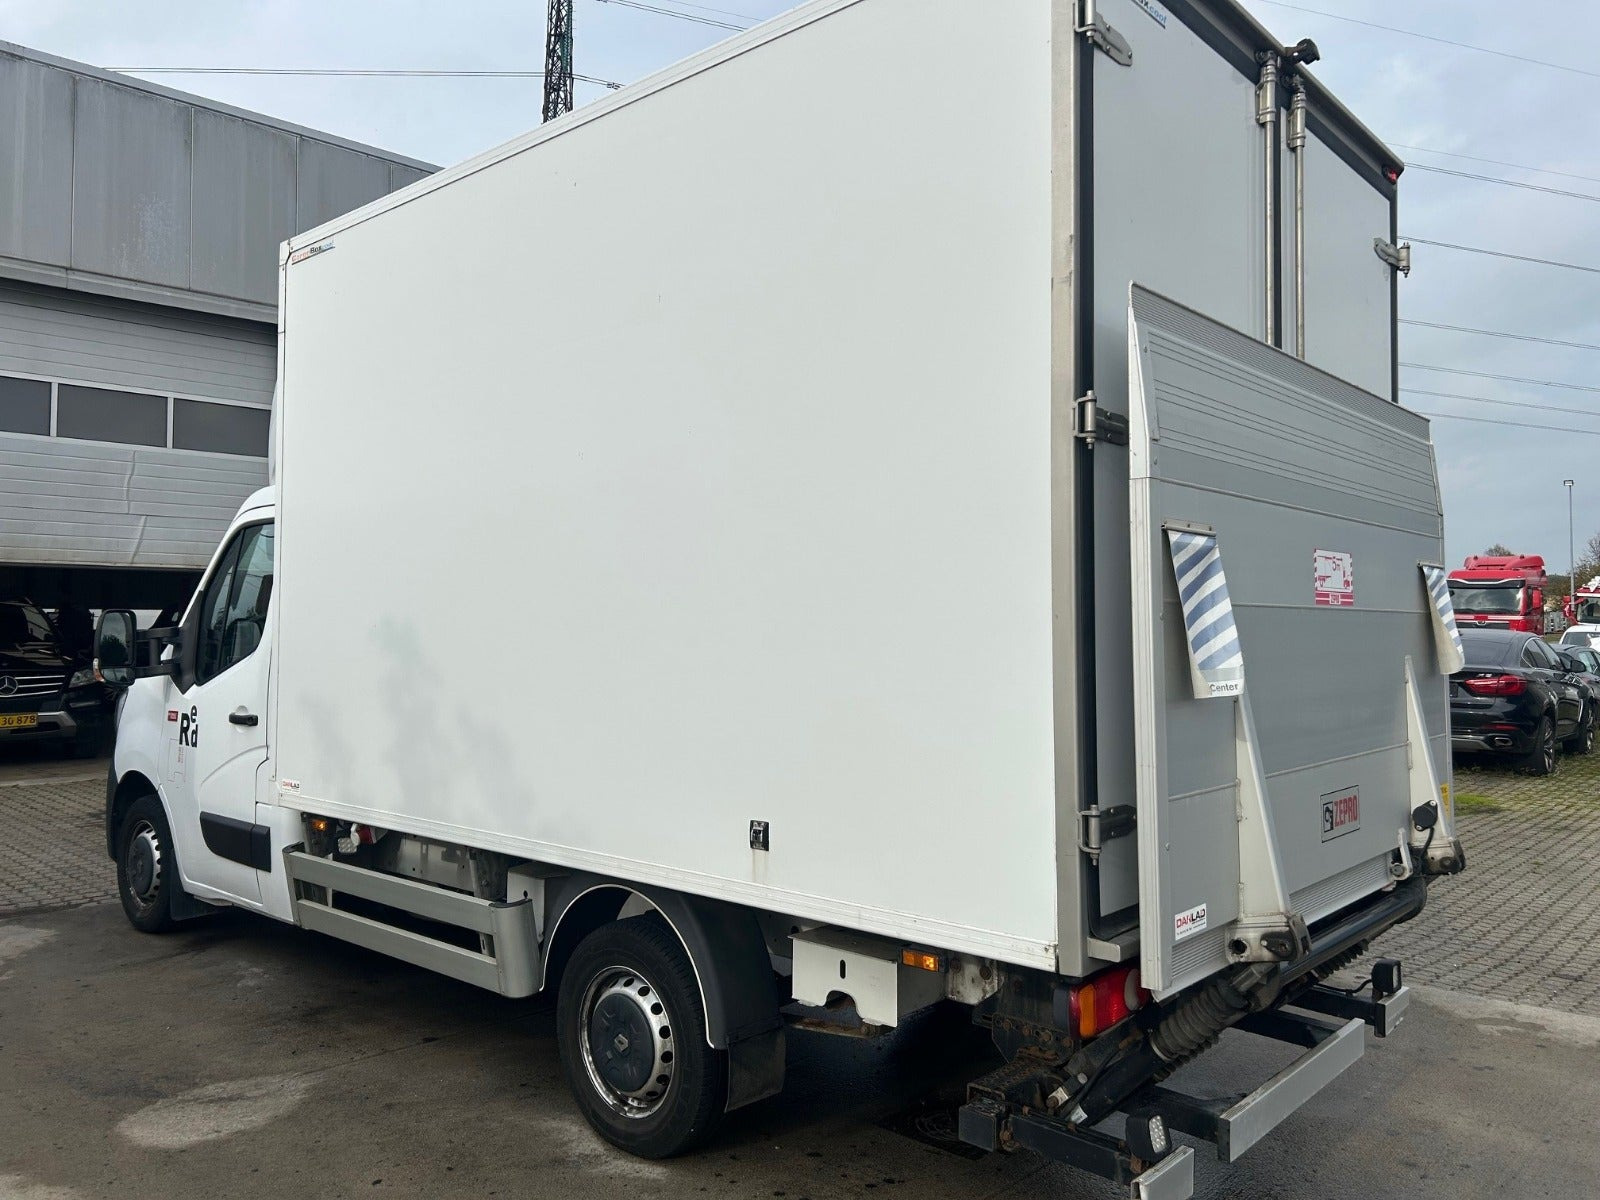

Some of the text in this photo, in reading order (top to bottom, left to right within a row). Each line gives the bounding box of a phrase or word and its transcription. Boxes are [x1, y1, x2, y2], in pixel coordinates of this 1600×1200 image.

[1209, 682, 1239, 692] Center
[16, 715, 36, 725] 878
[1333, 795, 1358, 827] ZEPRO
